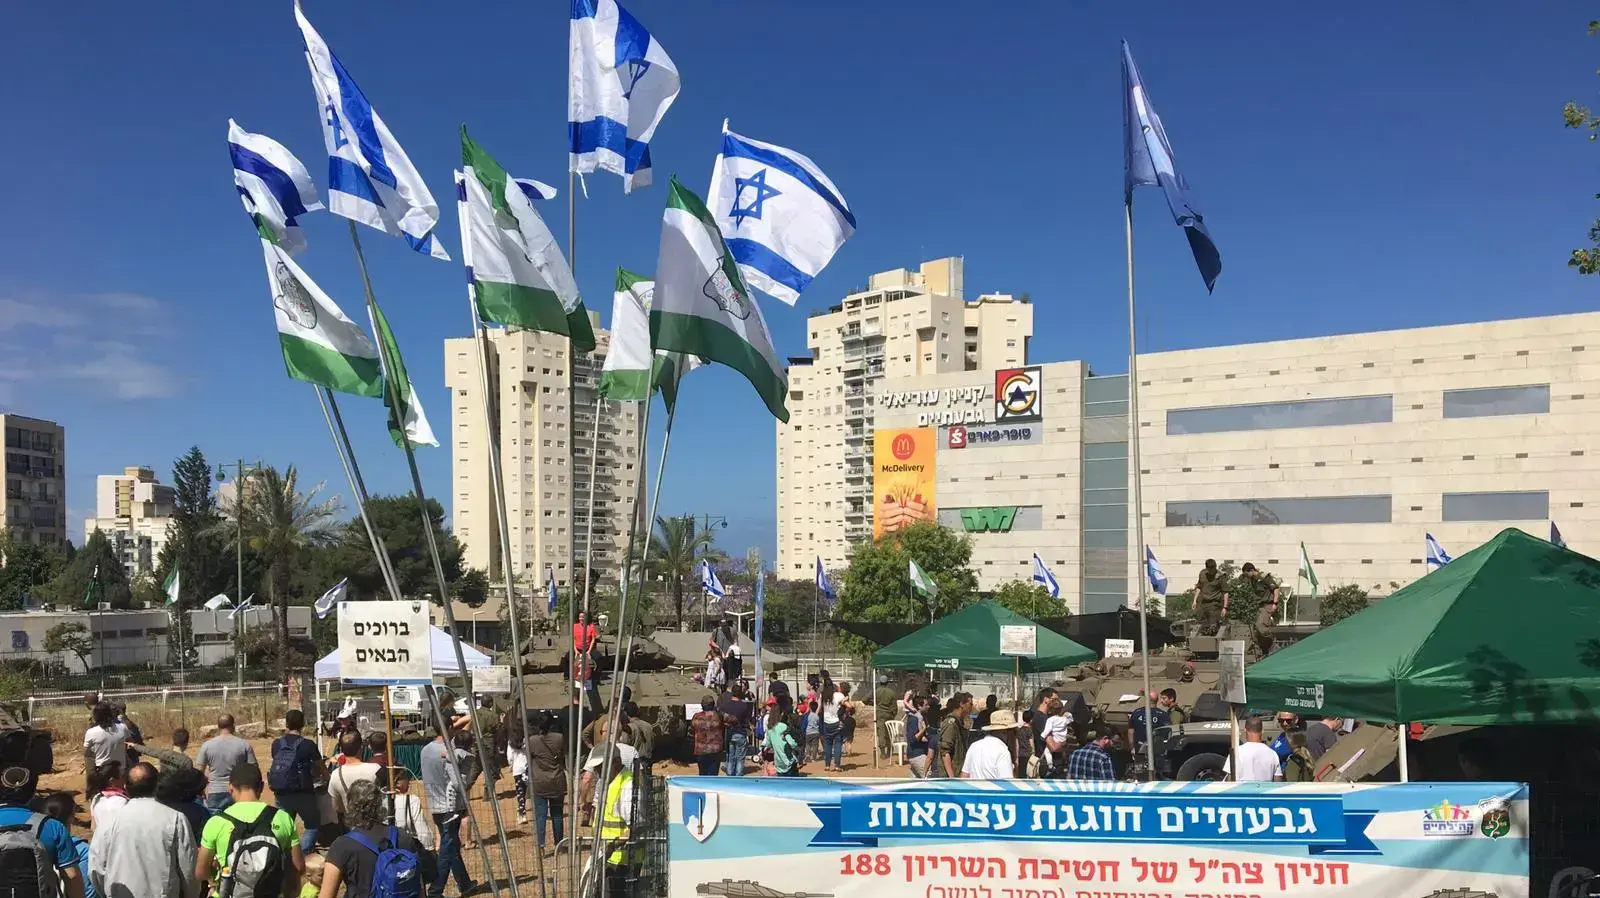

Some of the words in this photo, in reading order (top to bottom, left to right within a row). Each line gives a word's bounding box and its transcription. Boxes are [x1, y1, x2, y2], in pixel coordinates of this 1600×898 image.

[877, 388, 941, 409] עזריאלי
[944, 386, 987, 408] קניון
[918, 408, 986, 428] גבעתיים
[882, 464, 925, 473] McDelivery
[353, 620, 410, 636] ברוכים
[355, 648, 410, 663] הבאים
[868, 800, 1016, 830] עצמאות
[1030, 803, 1143, 833] חוגגת
[1157, 806, 1317, 835] גבעתיים
[841, 853, 891, 876] 188
[903, 855, 1007, 882] השריון
[1019, 856, 1120, 882] חטיבת
[1131, 859, 1178, 883] של
[1275, 862, 1349, 891] חניון
